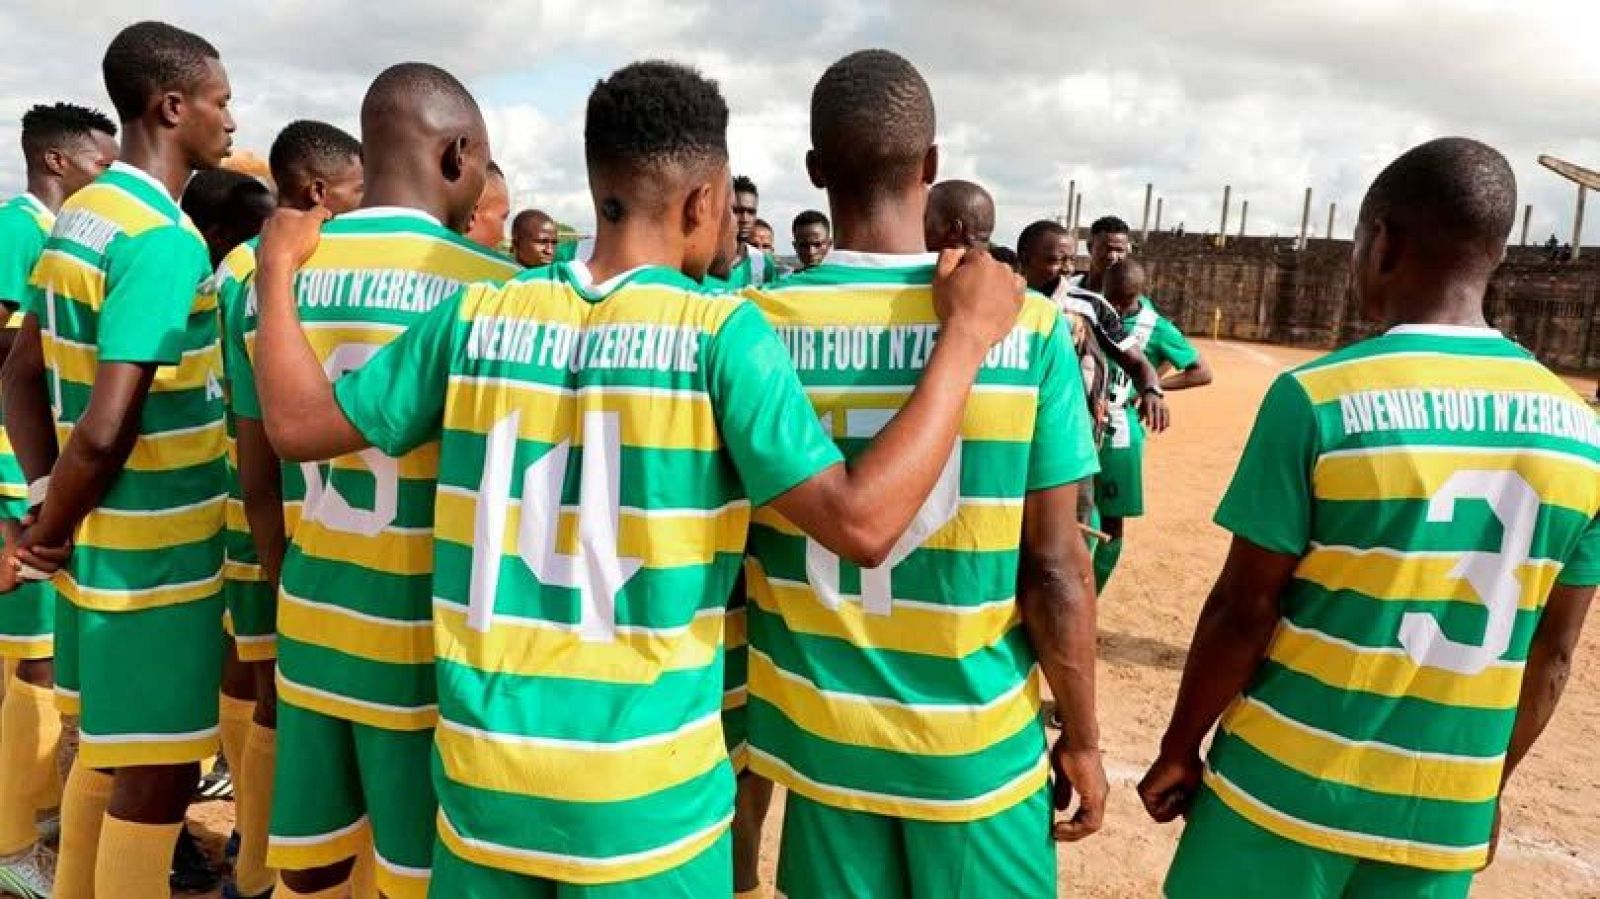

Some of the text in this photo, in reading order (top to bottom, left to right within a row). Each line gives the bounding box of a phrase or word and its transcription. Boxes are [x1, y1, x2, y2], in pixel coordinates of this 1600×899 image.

[298, 269, 353, 307] FOOT
[822, 325, 884, 371] FOOT
[1340, 389, 1428, 435] AVENIR
[1431, 388, 1493, 432] FOOT
[466, 408, 645, 643] 14
[1397, 468, 1540, 676] 3
